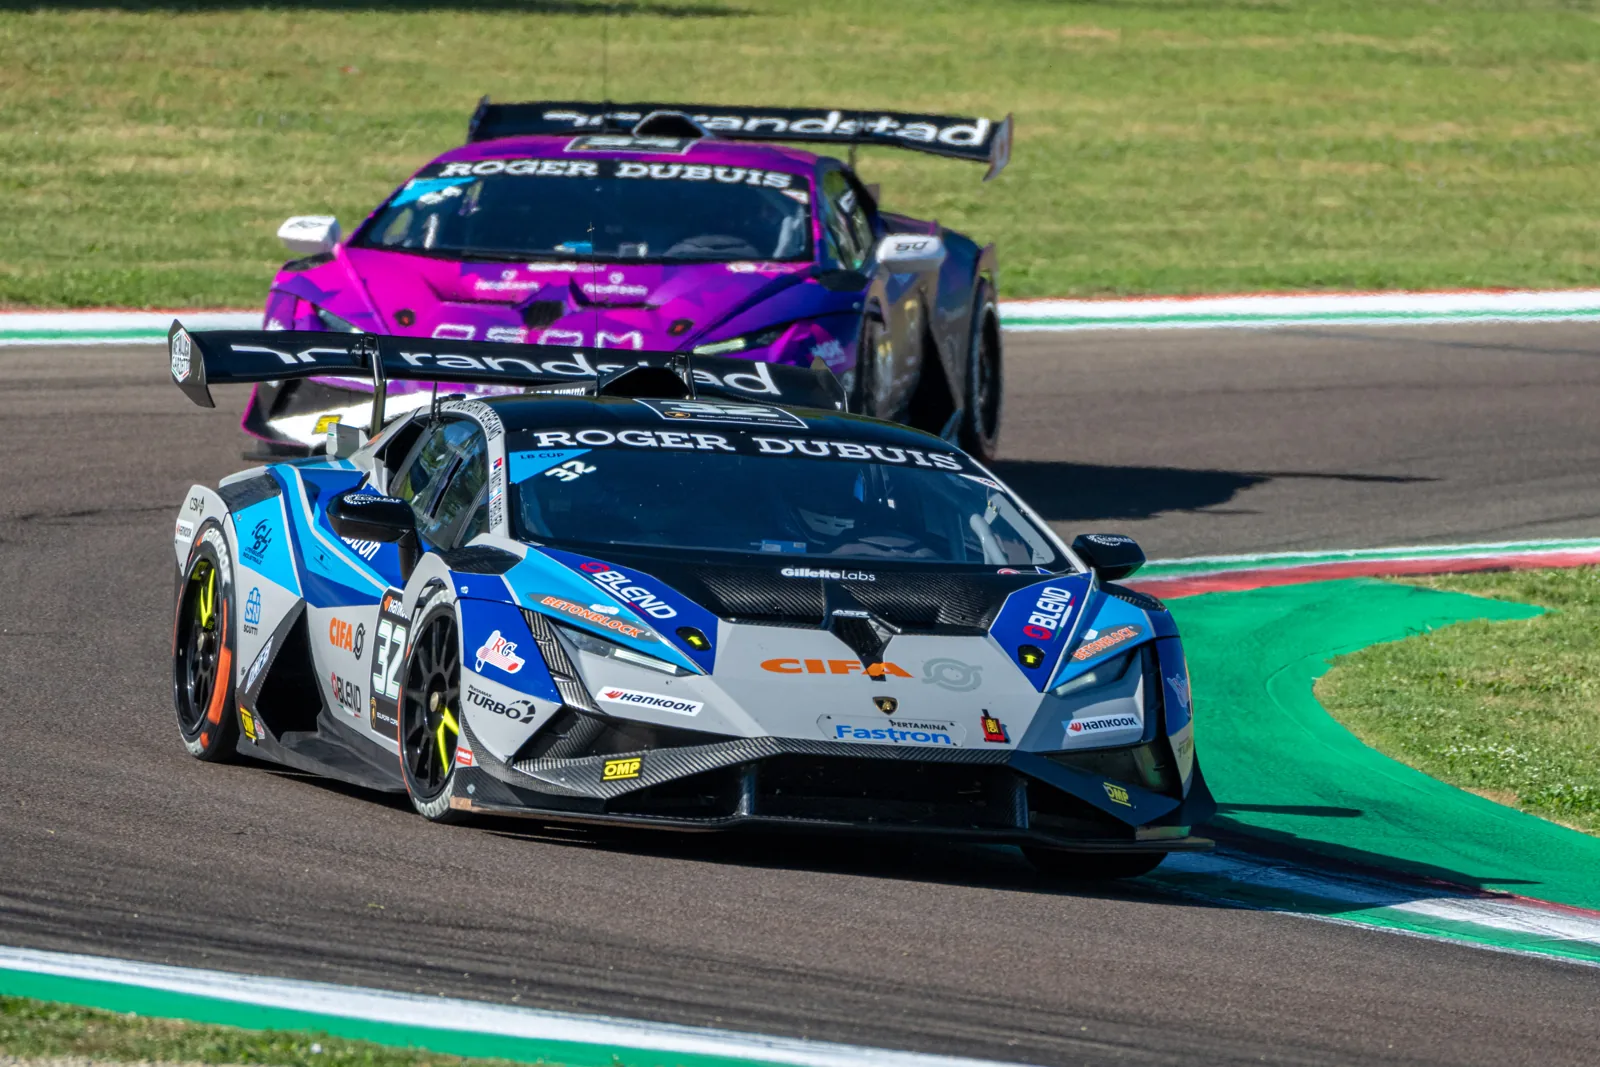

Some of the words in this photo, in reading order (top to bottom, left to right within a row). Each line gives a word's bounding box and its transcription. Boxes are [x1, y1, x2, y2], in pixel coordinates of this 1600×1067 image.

[438, 160, 598, 178] ROGER
[614, 162, 794, 188] DUBUIS
[533, 430, 737, 451] ROGER
[751, 437, 963, 471] DUBUIS
[544, 460, 598, 482] 32
[780, 567, 876, 581] GilletteLabs
[592, 570, 678, 620] BLEND
[1028, 586, 1072, 630] BLEND
[540, 595, 645, 638] BETONBLOCK
[329, 617, 353, 653] CIFA
[1072, 626, 1139, 661] BETONBLOCK
[372, 618, 407, 701] 32
[759, 658, 915, 679] CIFA
[336, 675, 362, 714] BLEND
[466, 689, 522, 720] TURBO
[835, 724, 953, 745] Fastron
[889, 720, 949, 732] PERTAMINA
[603, 761, 641, 776] OMP
[1105, 786, 1129, 802] OMP
